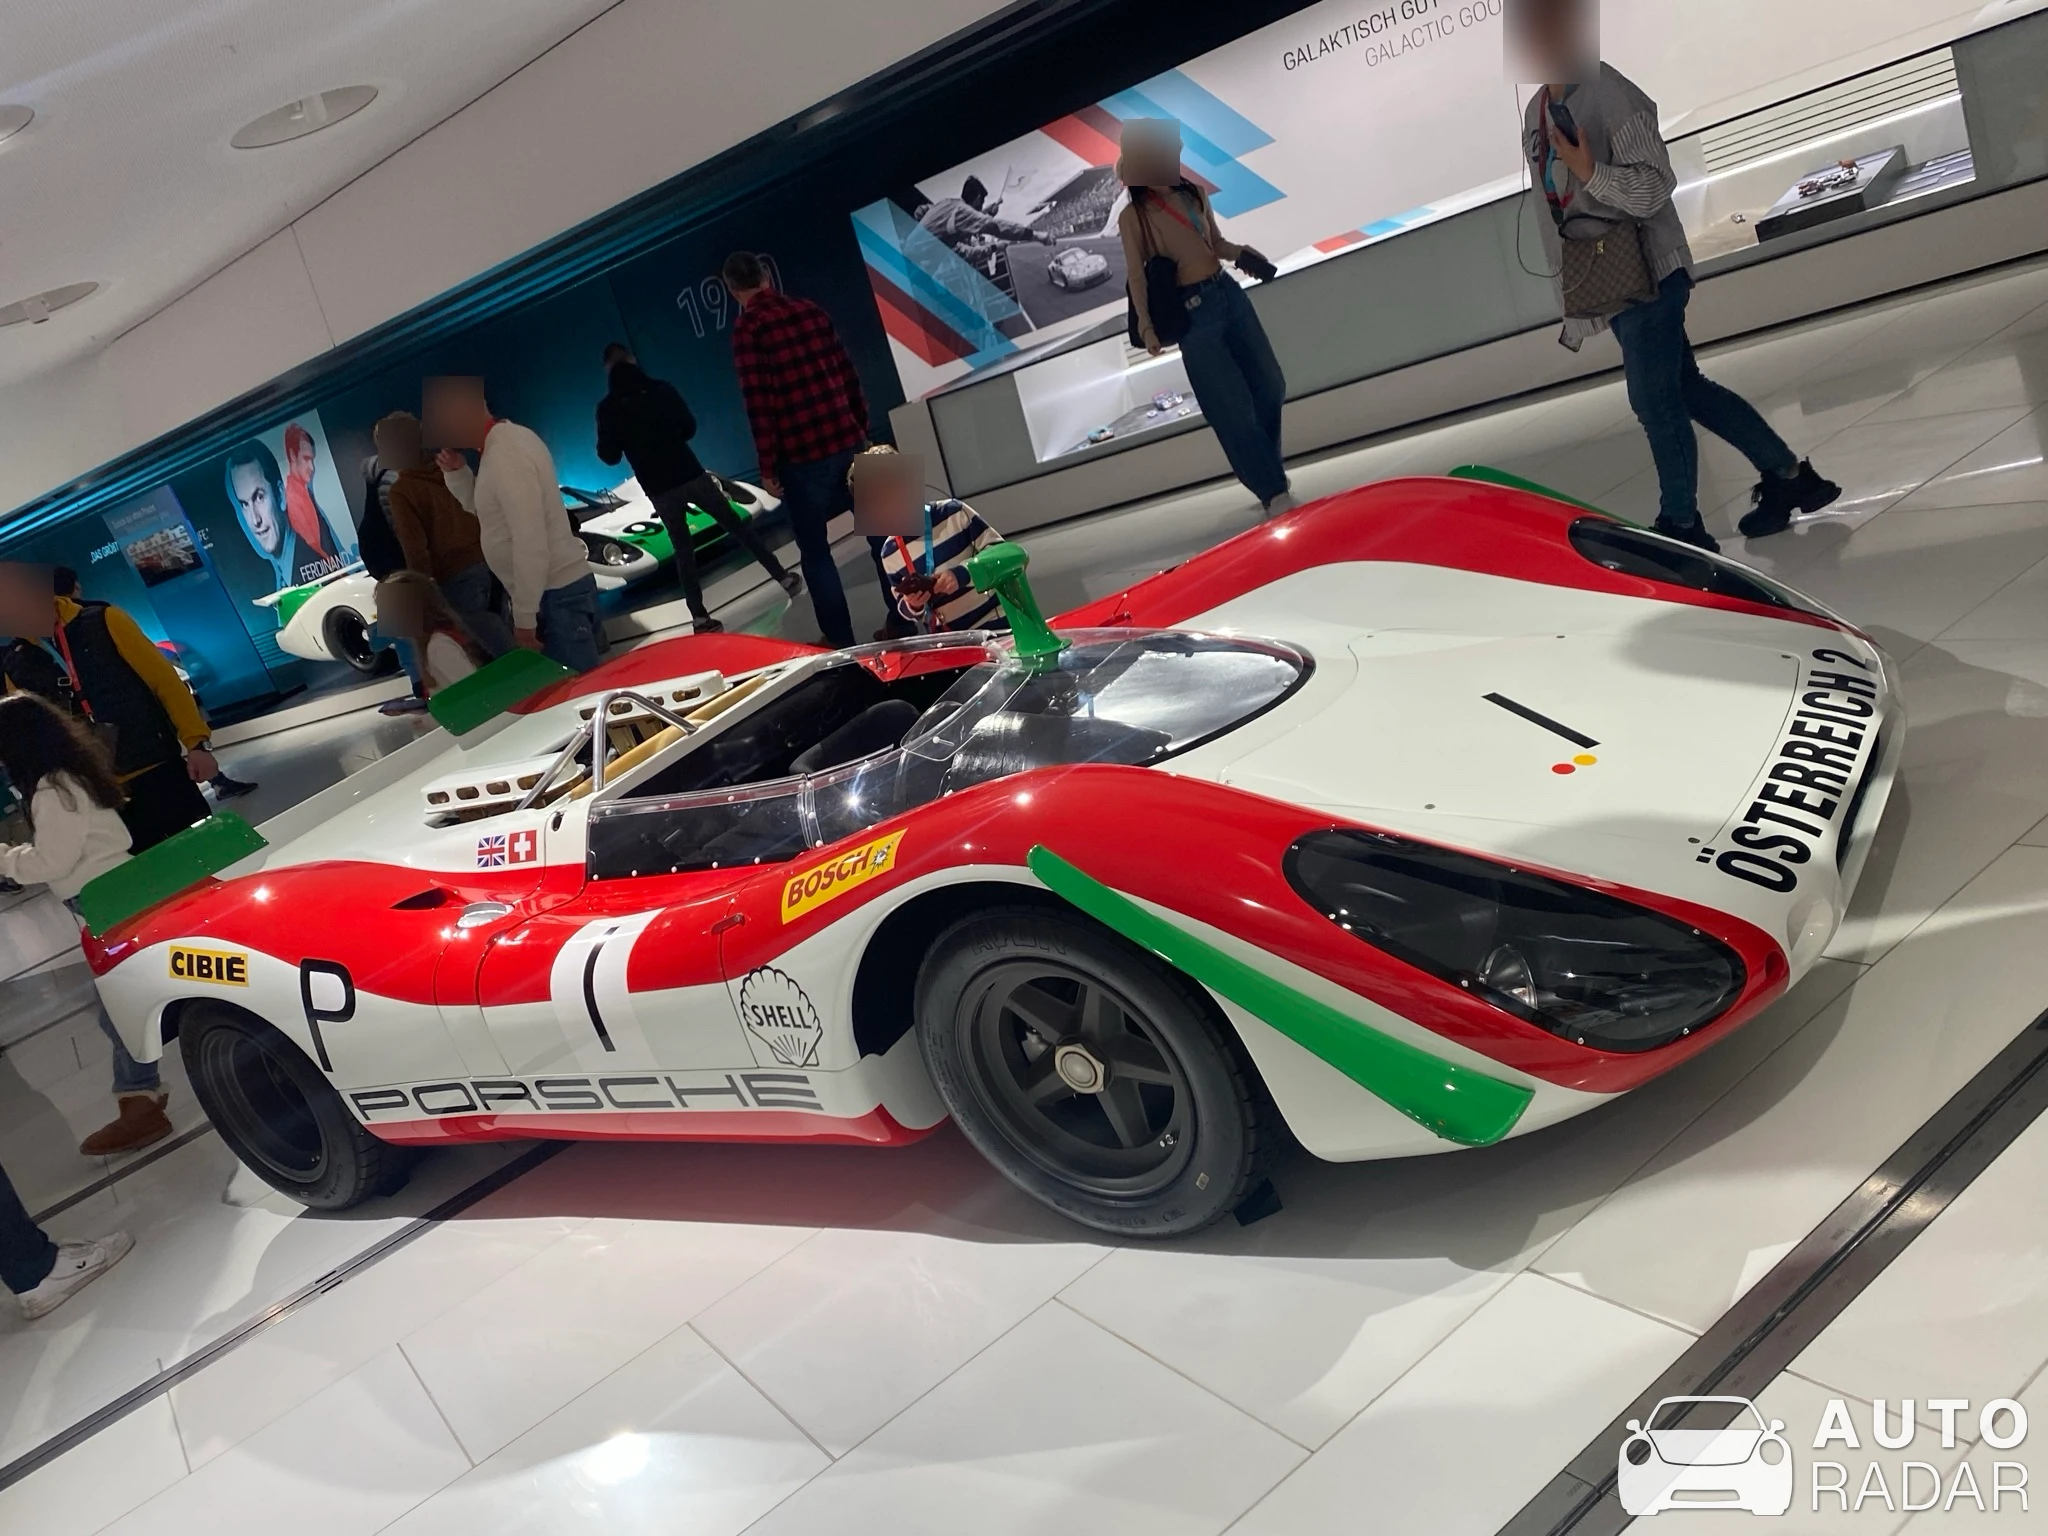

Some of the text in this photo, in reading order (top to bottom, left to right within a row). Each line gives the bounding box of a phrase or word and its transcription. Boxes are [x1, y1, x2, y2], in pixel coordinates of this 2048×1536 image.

[1283, 7, 1397, 71] GALAKTISCH
[1365, 0, 1502, 67] GALACTIC GOO
[300, 551, 351, 582] FERDINAND
[1695, 648, 1879, 893] ÖSTERREICH 2
[787, 846, 873, 909] BOSCH
[301, 957, 356, 1073] P
[751, 1004, 812, 1030] SHELL
[348, 1073, 824, 1121] PORSCHE
